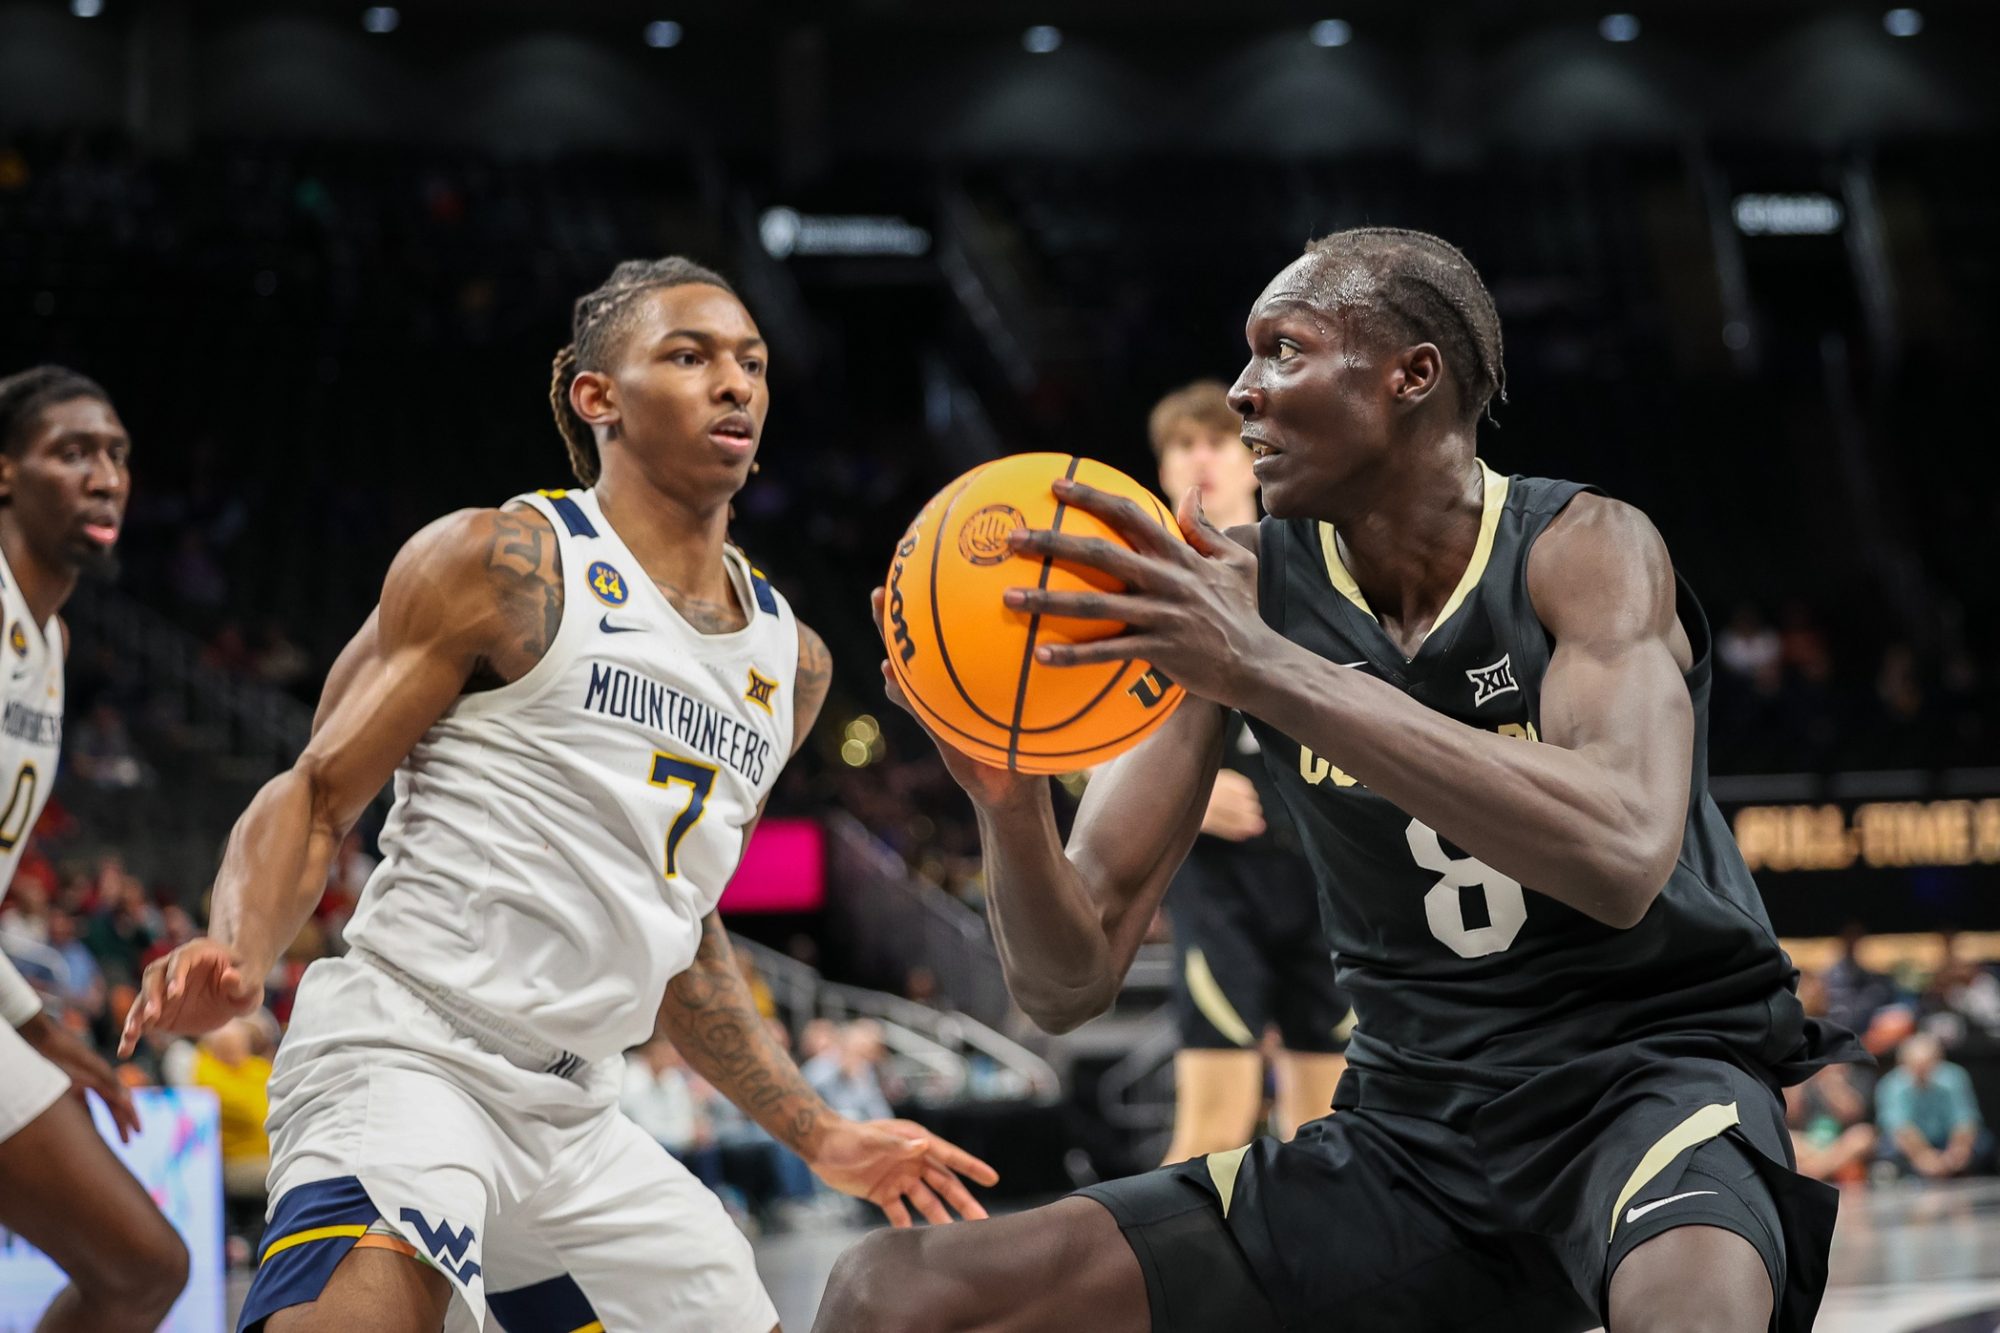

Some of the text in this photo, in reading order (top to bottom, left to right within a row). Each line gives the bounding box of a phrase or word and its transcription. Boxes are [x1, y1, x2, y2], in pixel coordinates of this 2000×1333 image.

[594, 575, 623, 600] 44
[584, 662, 770, 786] MOUNTAINEERS
[648, 751, 720, 880] 7
[1405, 817, 1528, 959] 8
